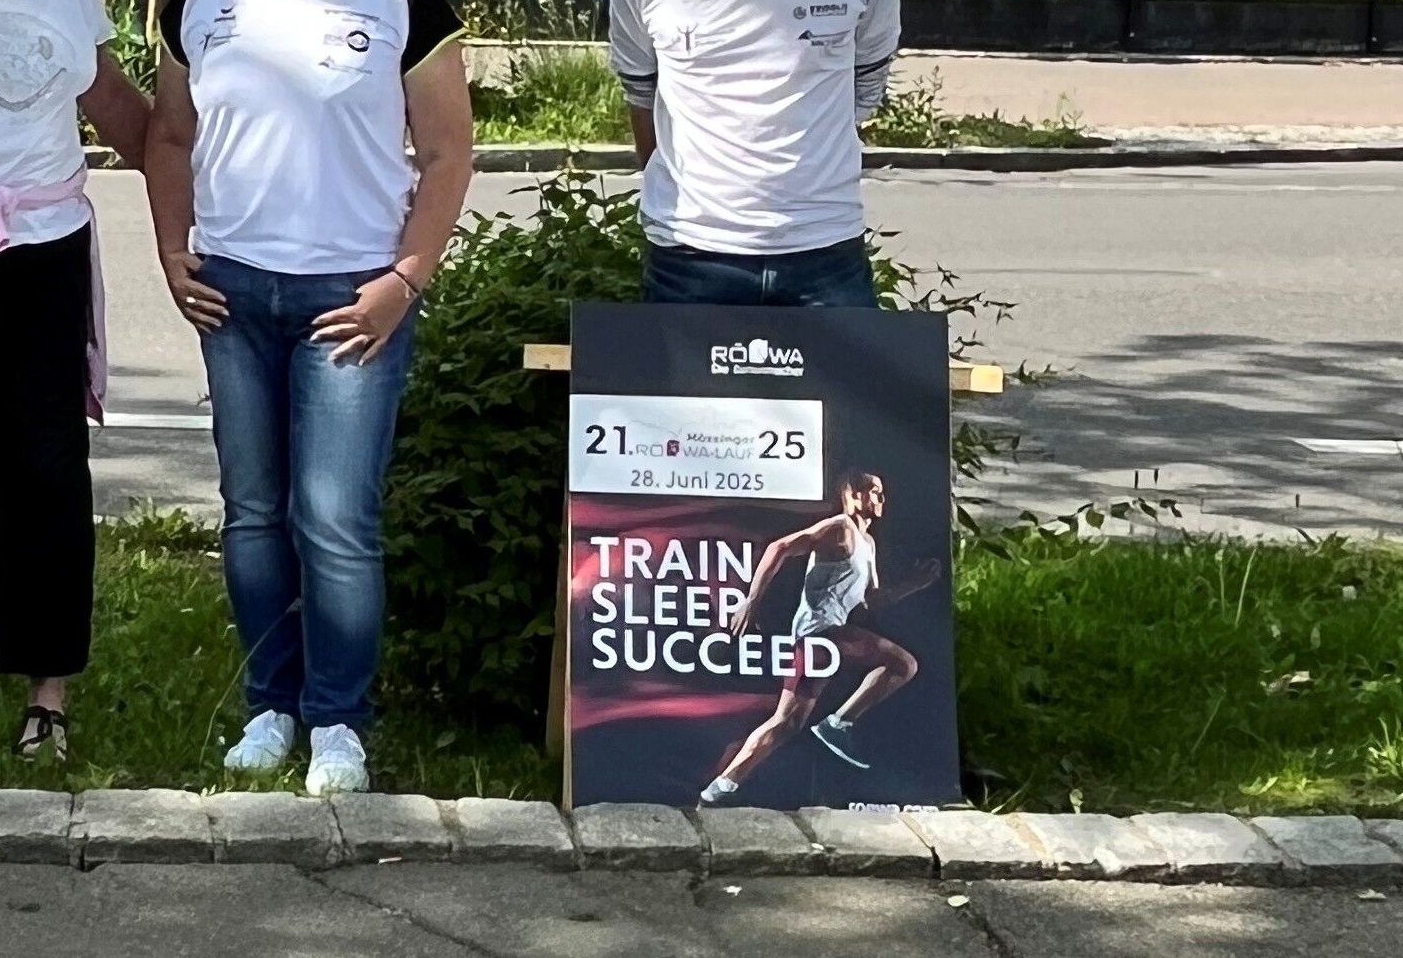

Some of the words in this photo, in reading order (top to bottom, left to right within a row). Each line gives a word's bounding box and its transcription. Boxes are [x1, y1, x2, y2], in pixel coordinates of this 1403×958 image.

[758, 430, 806, 460] 25
[630, 469, 660, 488] 28.
[666, 470, 708, 489] Juni
[716, 472, 764, 491] 2025
[590, 536, 753, 583] TRAIN
[590, 582, 747, 628] SLEEP
[590, 628, 842, 679] SUCCEED
